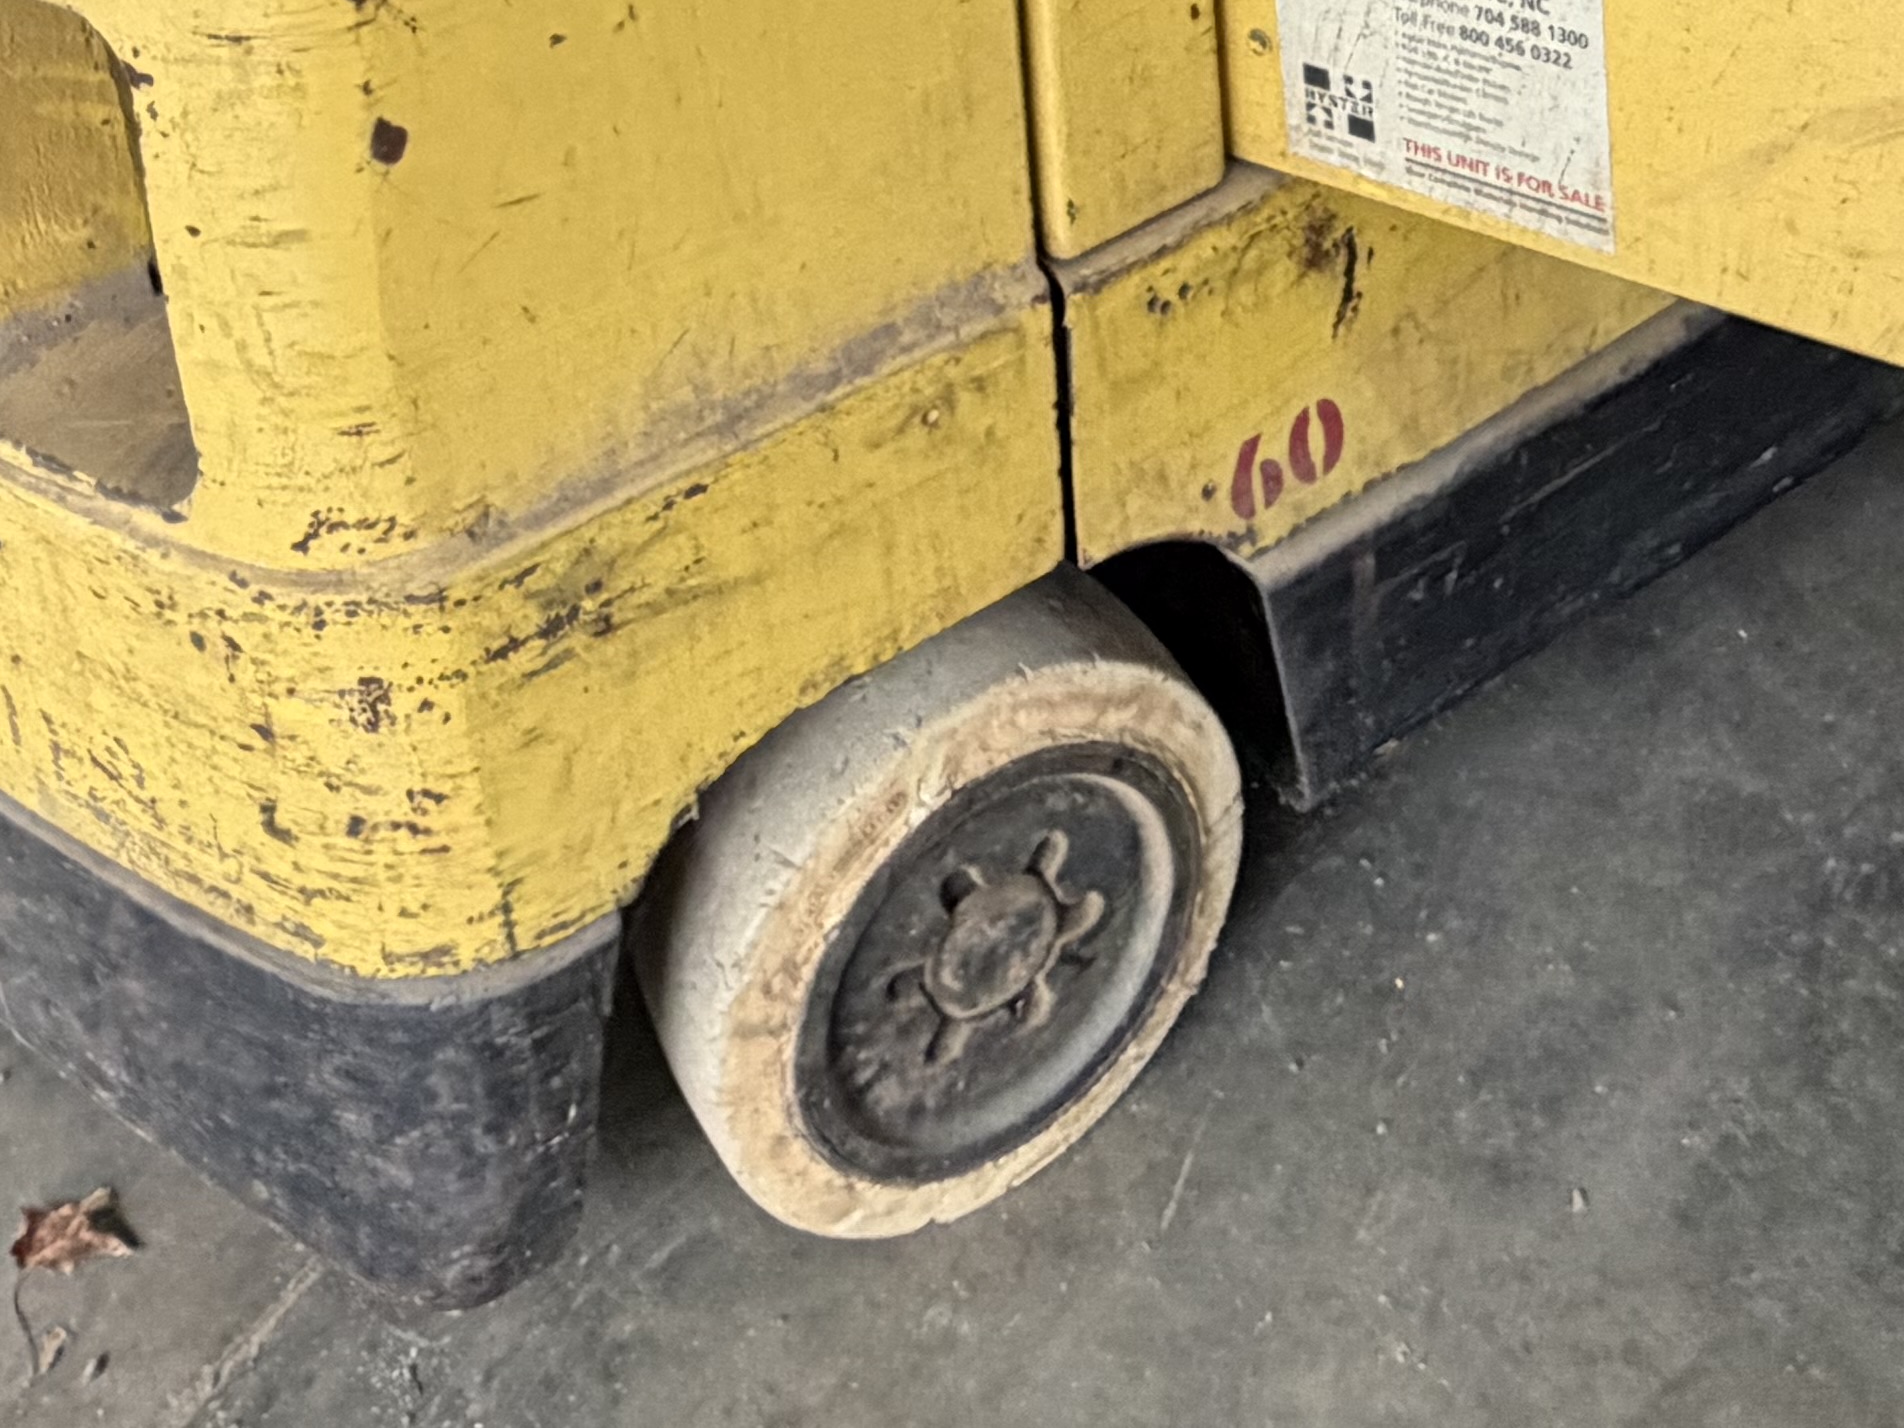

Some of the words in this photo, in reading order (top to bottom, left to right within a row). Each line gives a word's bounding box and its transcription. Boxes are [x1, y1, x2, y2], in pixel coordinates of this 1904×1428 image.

[1394, 7, 1418, 27] Toll
[1422, 13, 1456, 37] Free
[1458, 25, 1490, 47] 800
[1494, 34, 1526, 58] 456
[1529, 42, 1573, 69] 0322
[1474, 6, 1506, 29] 704
[1509, 13, 1542, 38] 588
[1548, 23, 1590, 50] 1300
[1403, 137, 1442, 163] THIS
[1447, 151, 1490, 177] UNIT
[1495, 163, 1514, 183] IS
[1517, 172, 1554, 199] FOR
[1558, 185, 1607, 212] SALE
[1230, 398, 1344, 520] 60
